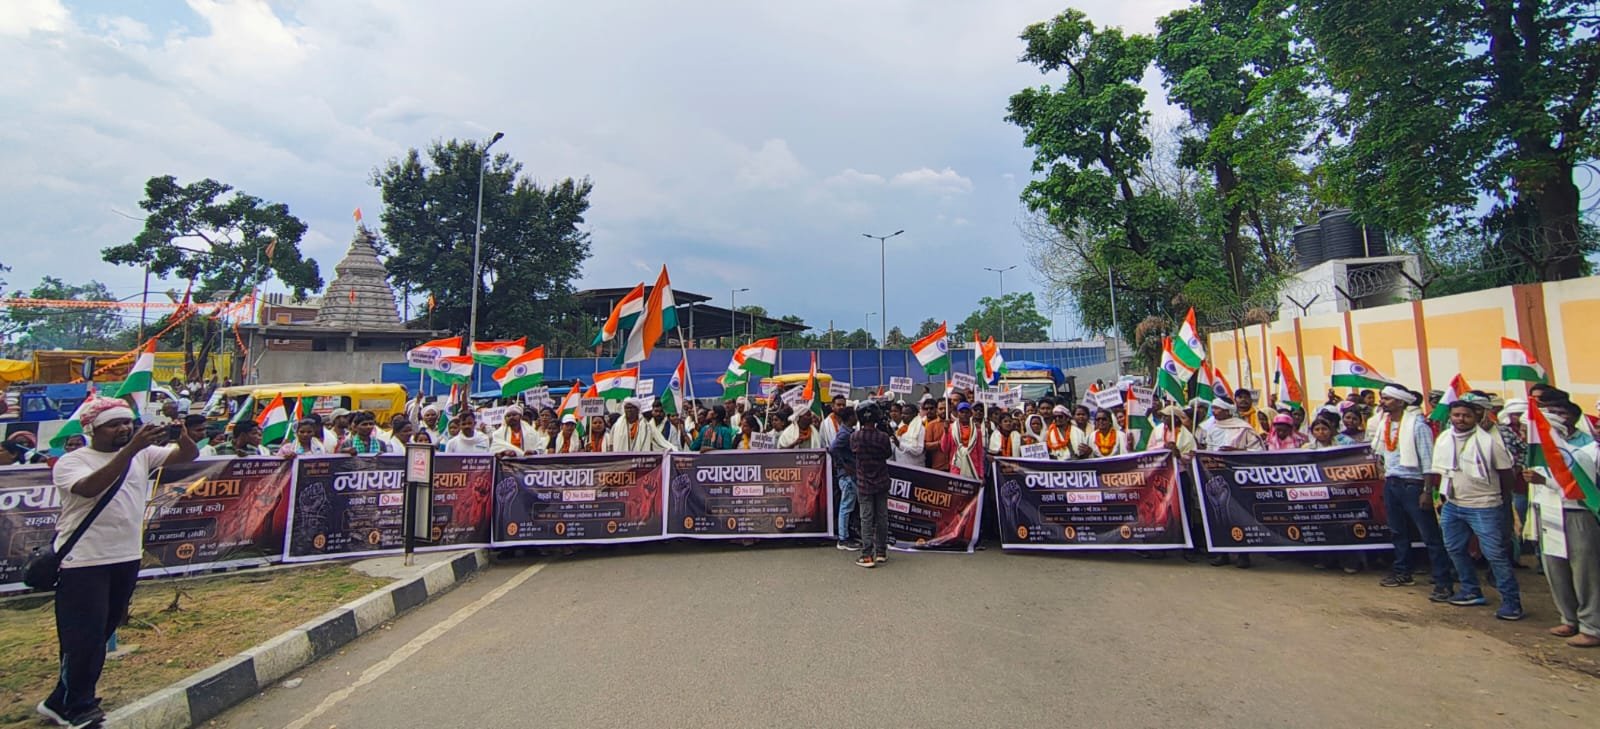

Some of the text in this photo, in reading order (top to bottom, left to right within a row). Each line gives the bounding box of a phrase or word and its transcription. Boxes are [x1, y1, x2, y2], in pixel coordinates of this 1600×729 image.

[333, 470, 467, 490] न्यायया दयात्रा
[524, 469, 636, 487] न्याययात्रा पदयात्रा
[697, 465, 801, 482] न्याययात्रा पदयात्रा
[1024, 470, 1145, 488] न्याययात्रा पदयात्रा
[1232, 463, 1377, 484] न्याययात्रा पदयात्रा
[914, 487, 951, 507] पदयात्रा
[1275, 490, 1284, 498] पर
[1311, 488, 1327, 498] Entry
[160, 505, 182, 516] नियम
[186, 504, 203, 515] लागू
